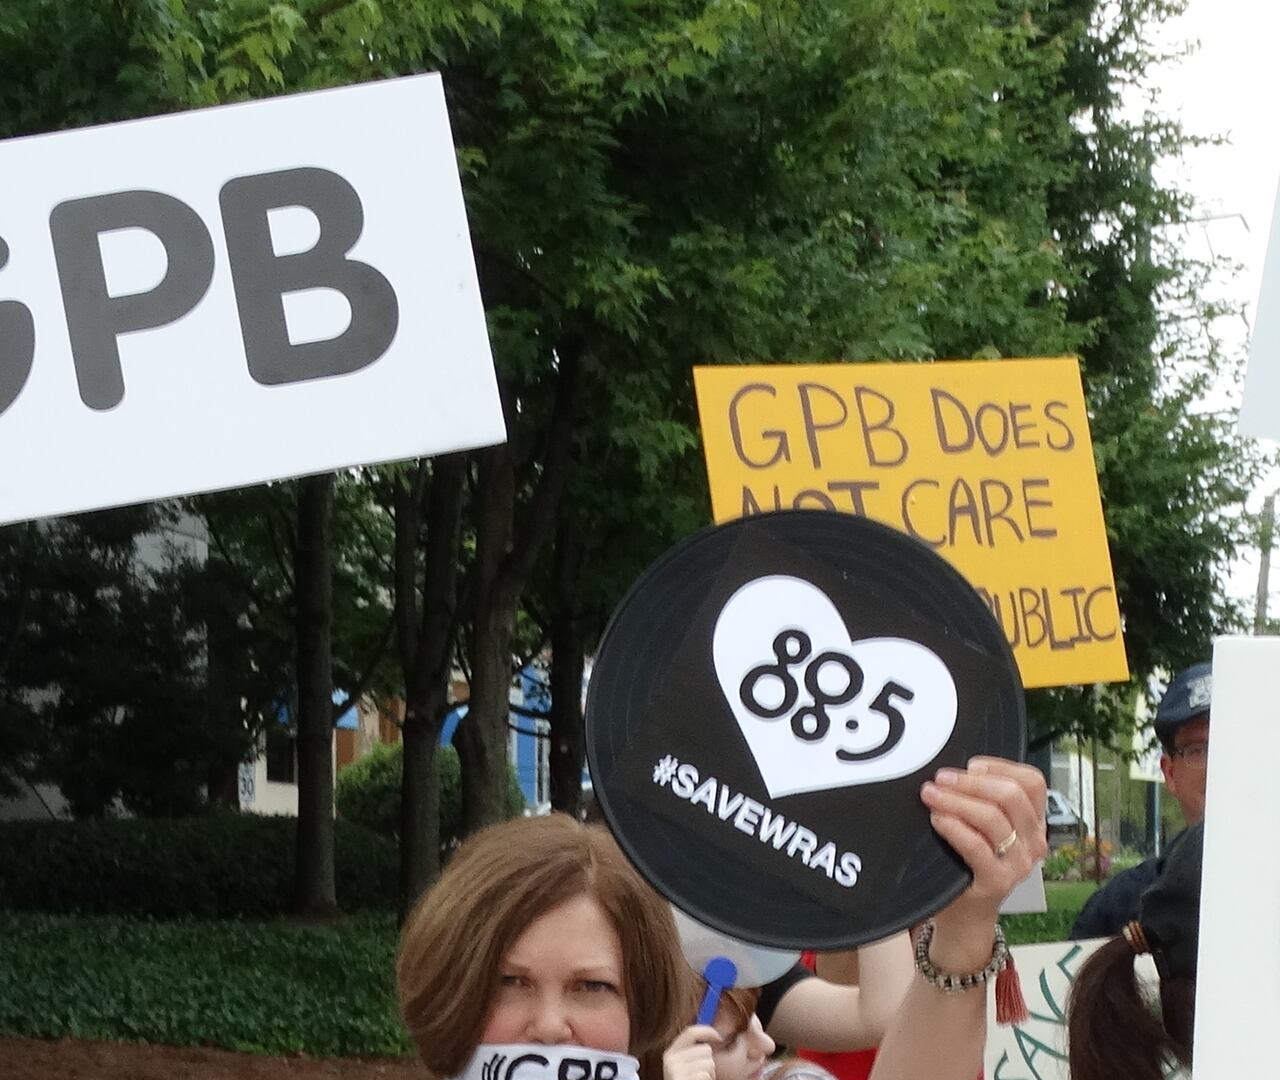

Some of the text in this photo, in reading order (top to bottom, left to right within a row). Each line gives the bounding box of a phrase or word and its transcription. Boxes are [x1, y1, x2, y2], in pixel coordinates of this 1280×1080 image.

[728, 382, 1075, 470] GPB DOES
[901, 477, 1058, 549] CARE
[976, 584, 1117, 652] UBLIC
[738, 628, 915, 762] 88.5
[651, 753, 864, 889] #SAVEWRAS
